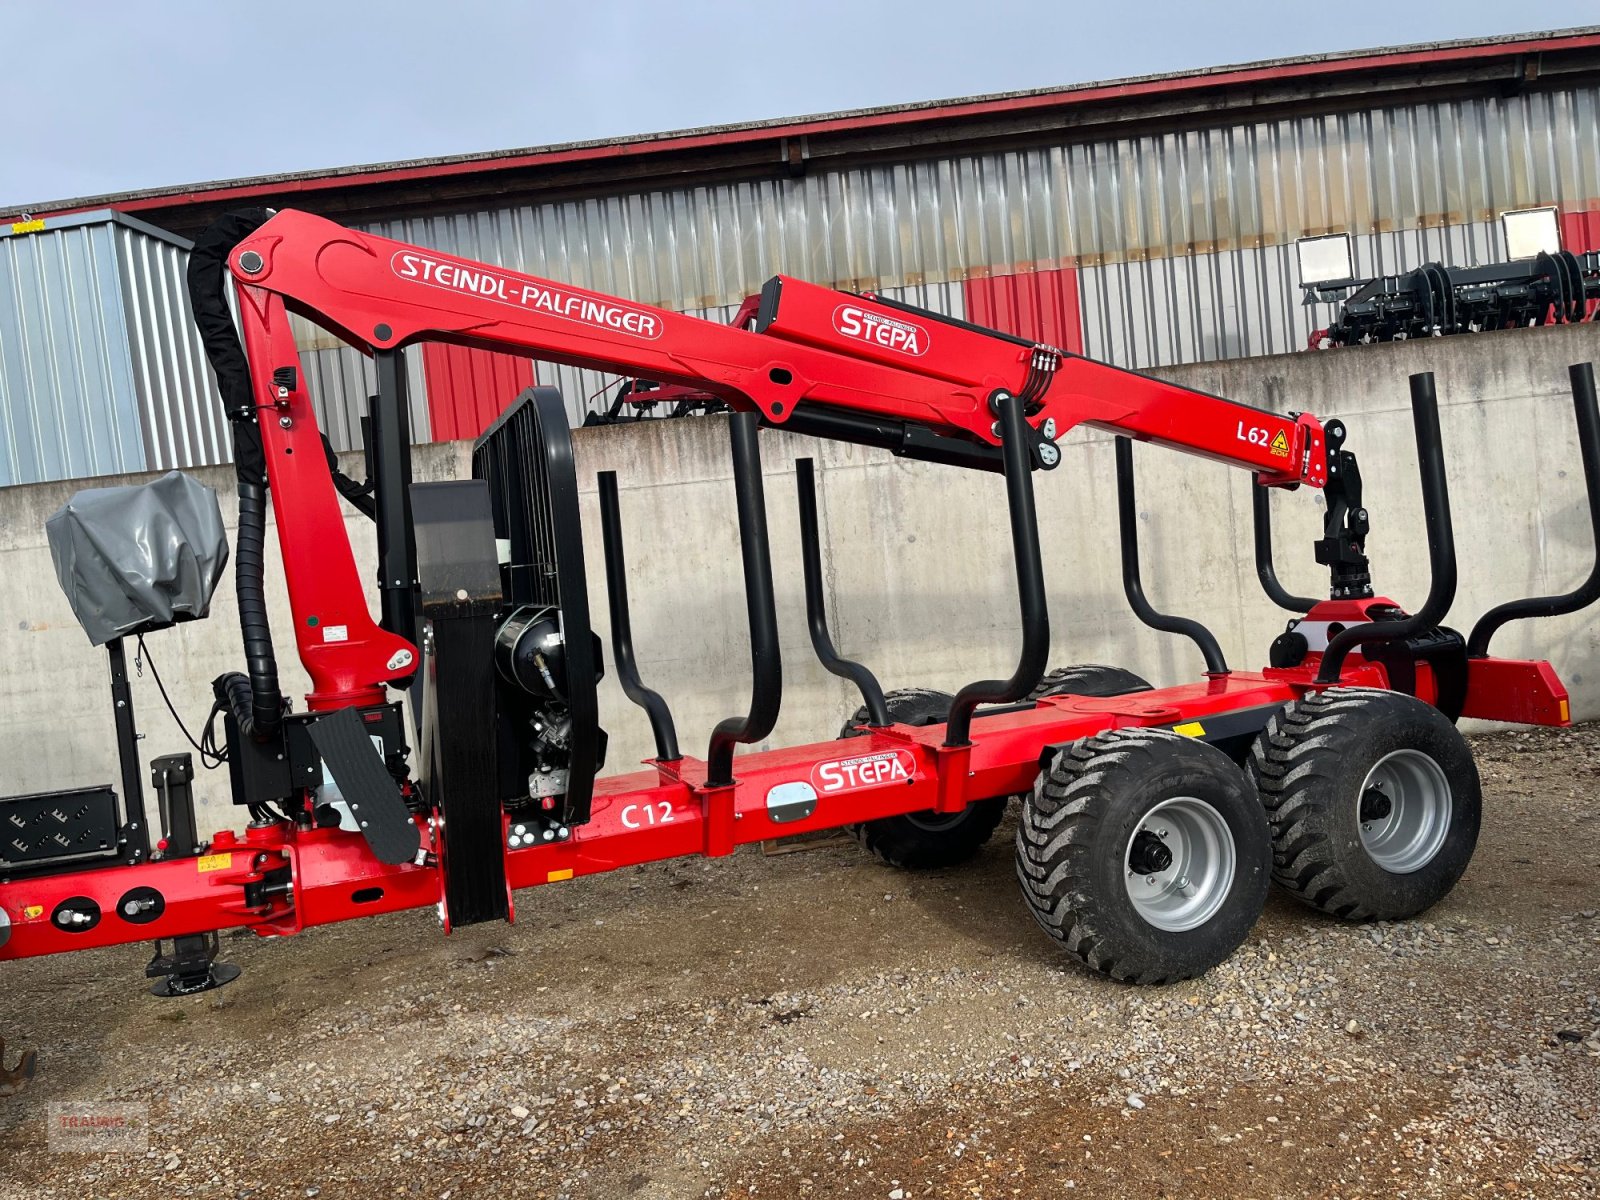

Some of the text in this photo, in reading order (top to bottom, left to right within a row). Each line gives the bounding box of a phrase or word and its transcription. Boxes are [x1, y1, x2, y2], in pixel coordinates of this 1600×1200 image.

[400, 255, 655, 336] STEINDL-PALFINGER
[840, 308, 919, 354] STEPA
[1237, 421, 1269, 447] L62
[819, 758, 908, 791] STEPA
[621, 801, 674, 828] C12
